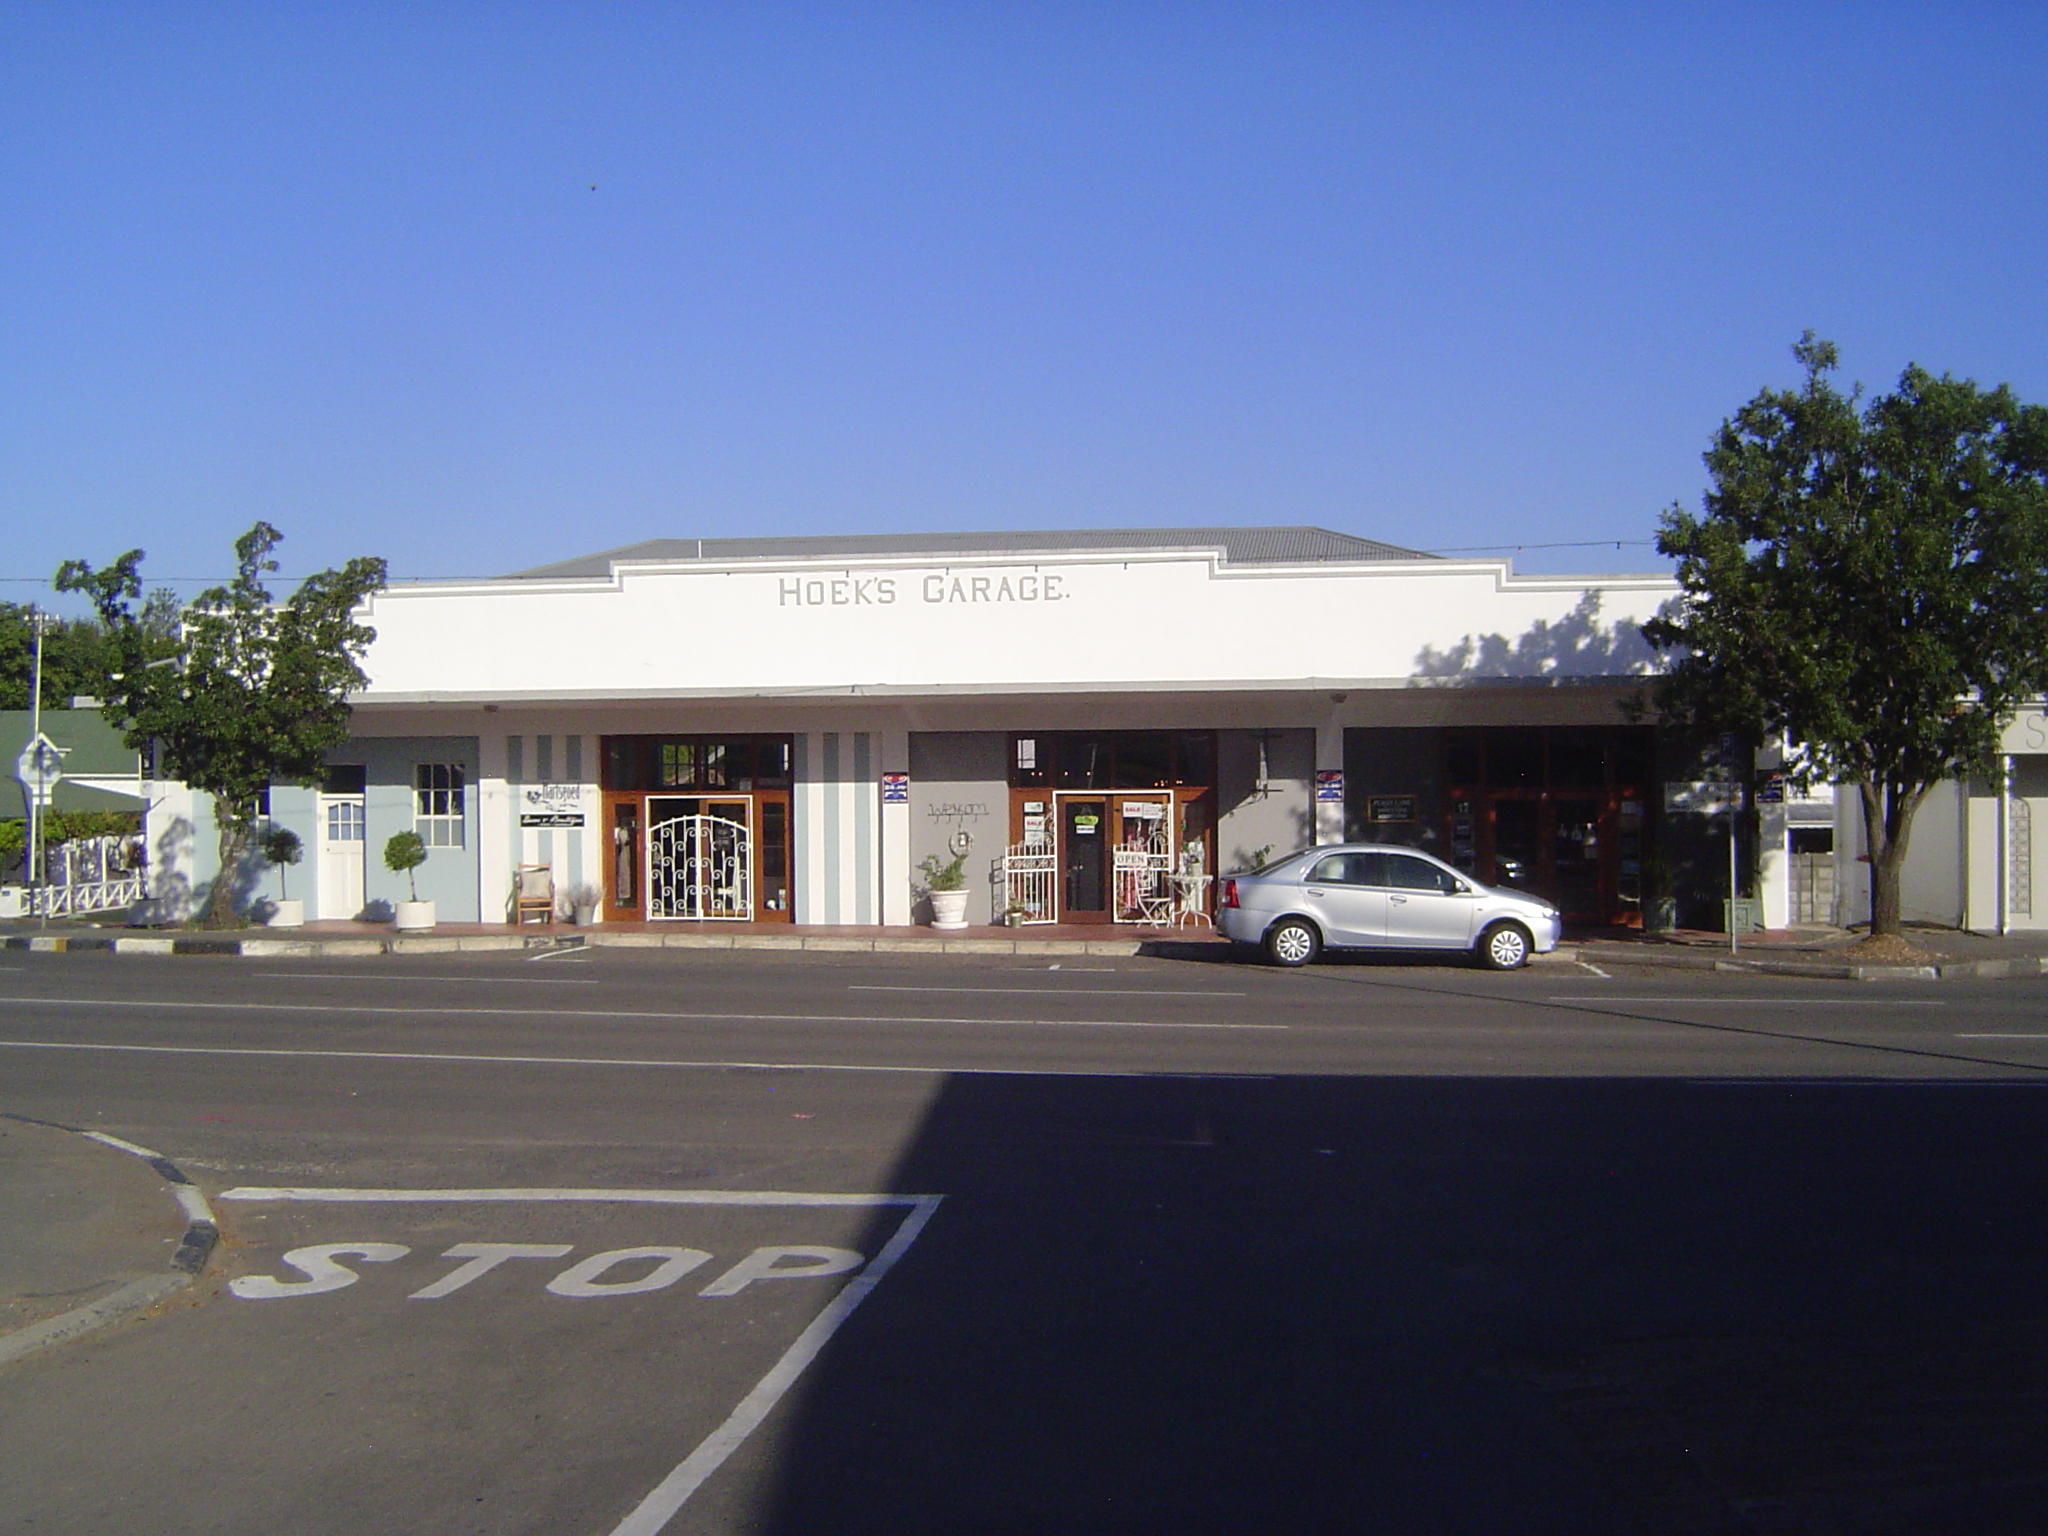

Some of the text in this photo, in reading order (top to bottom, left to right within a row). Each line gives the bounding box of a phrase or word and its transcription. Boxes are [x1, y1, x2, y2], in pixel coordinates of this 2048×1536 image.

[778, 576, 897, 606] HOEK'S
[1117, 853, 1144, 864] OPEN
[229, 1242, 866, 1300] STOP
